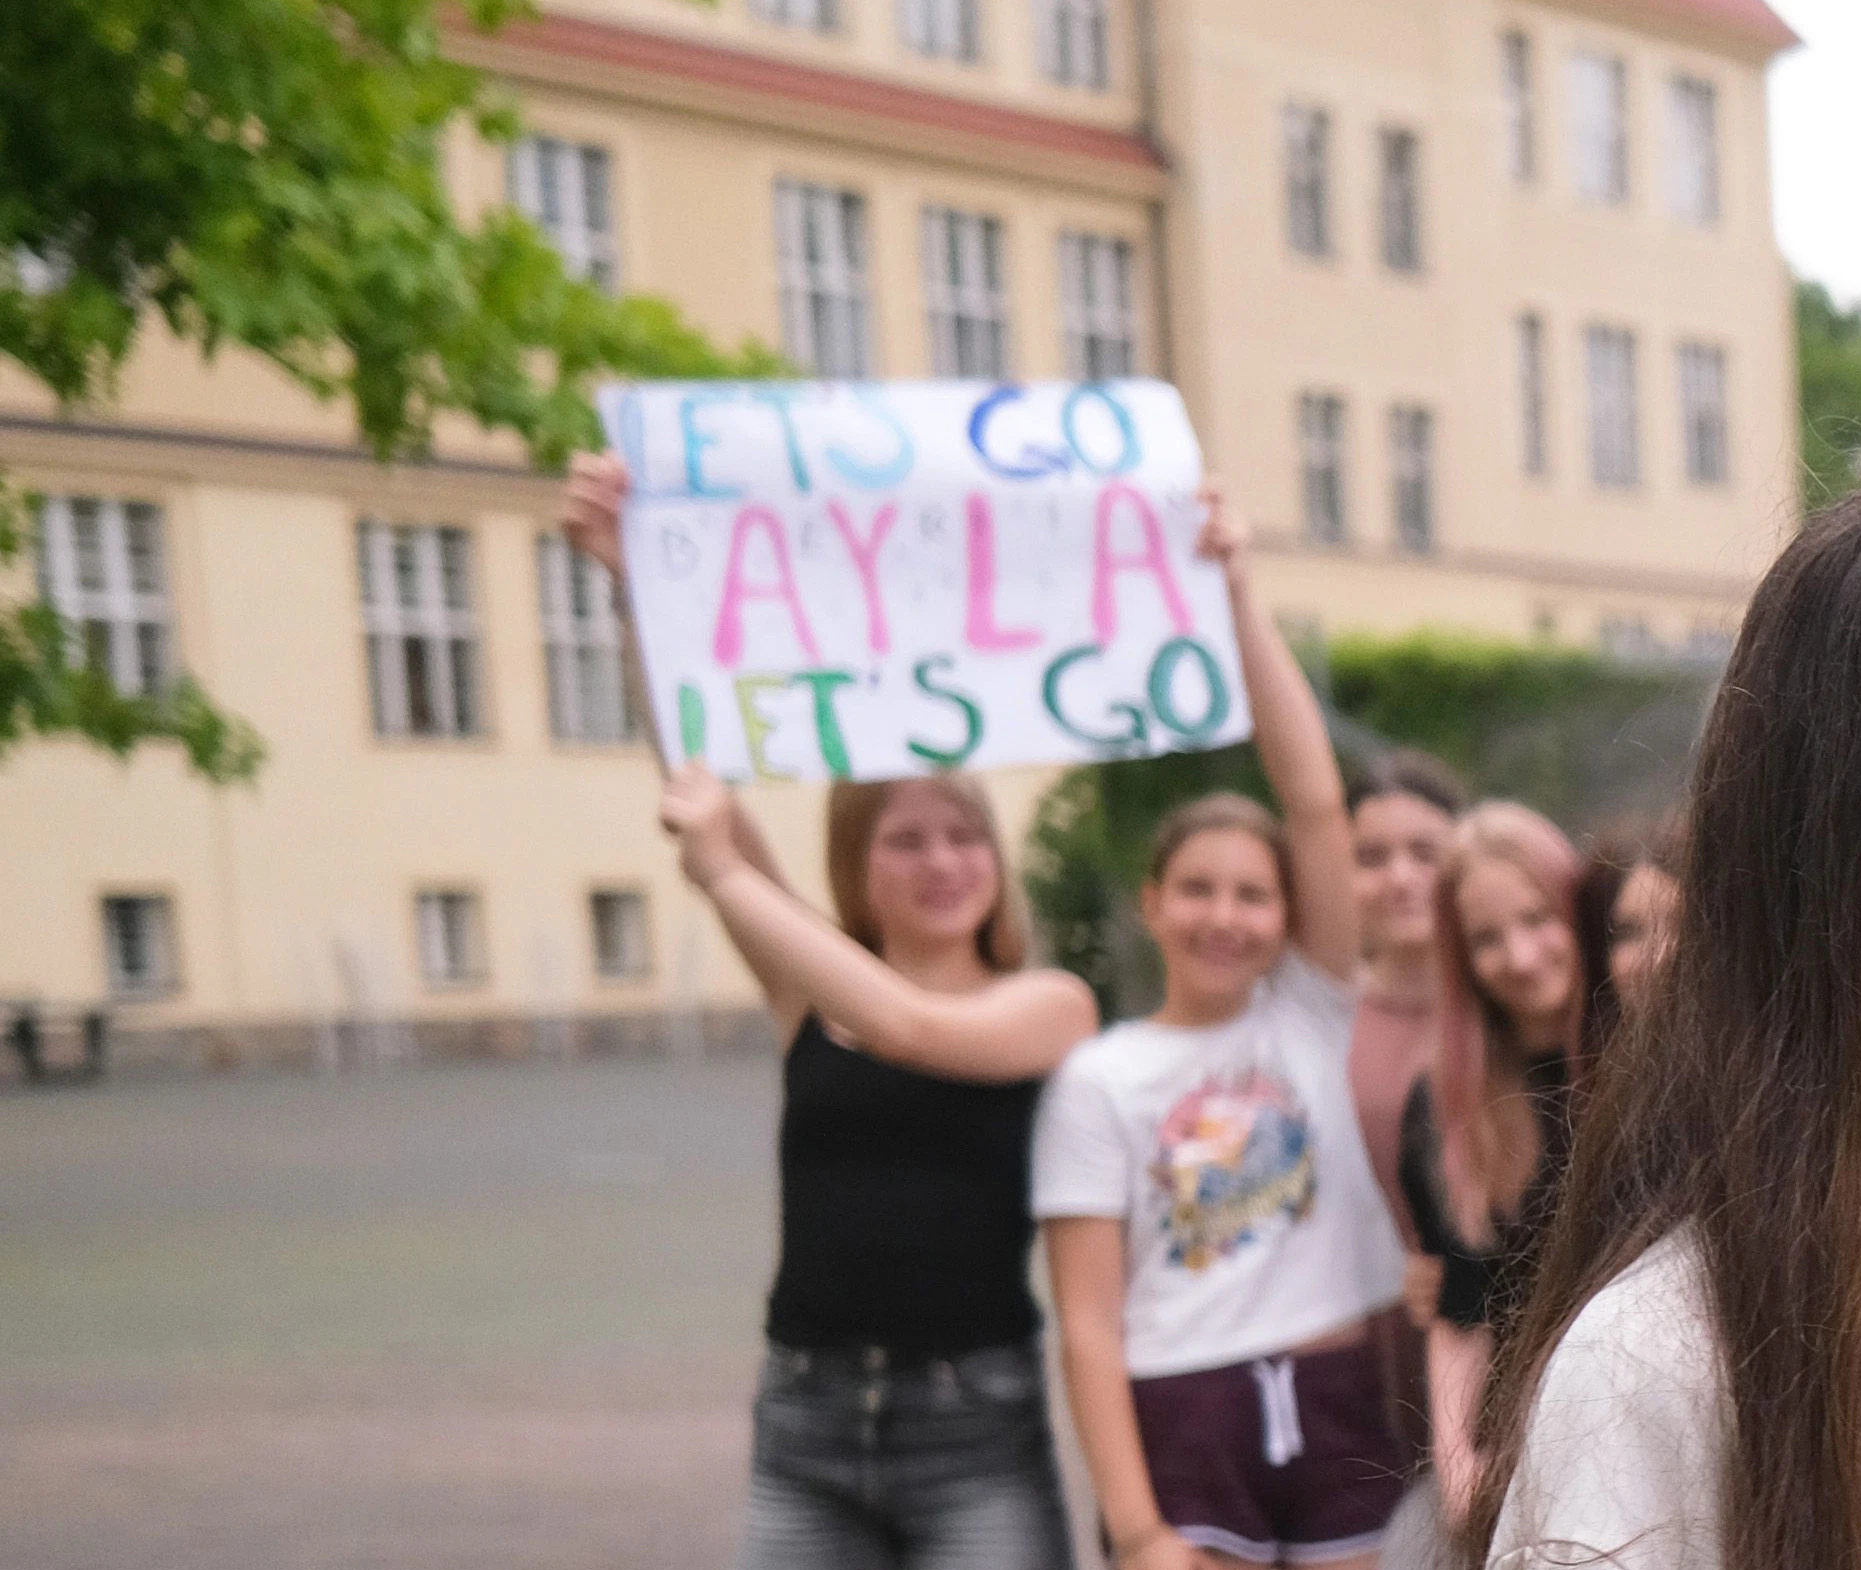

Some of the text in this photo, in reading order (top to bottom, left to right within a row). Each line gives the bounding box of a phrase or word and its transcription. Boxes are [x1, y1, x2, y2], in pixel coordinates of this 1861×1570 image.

[967, 384, 1142, 480] GO
[712, 480, 1198, 672] AYLA
[1042, 637, 1230, 746] GO
